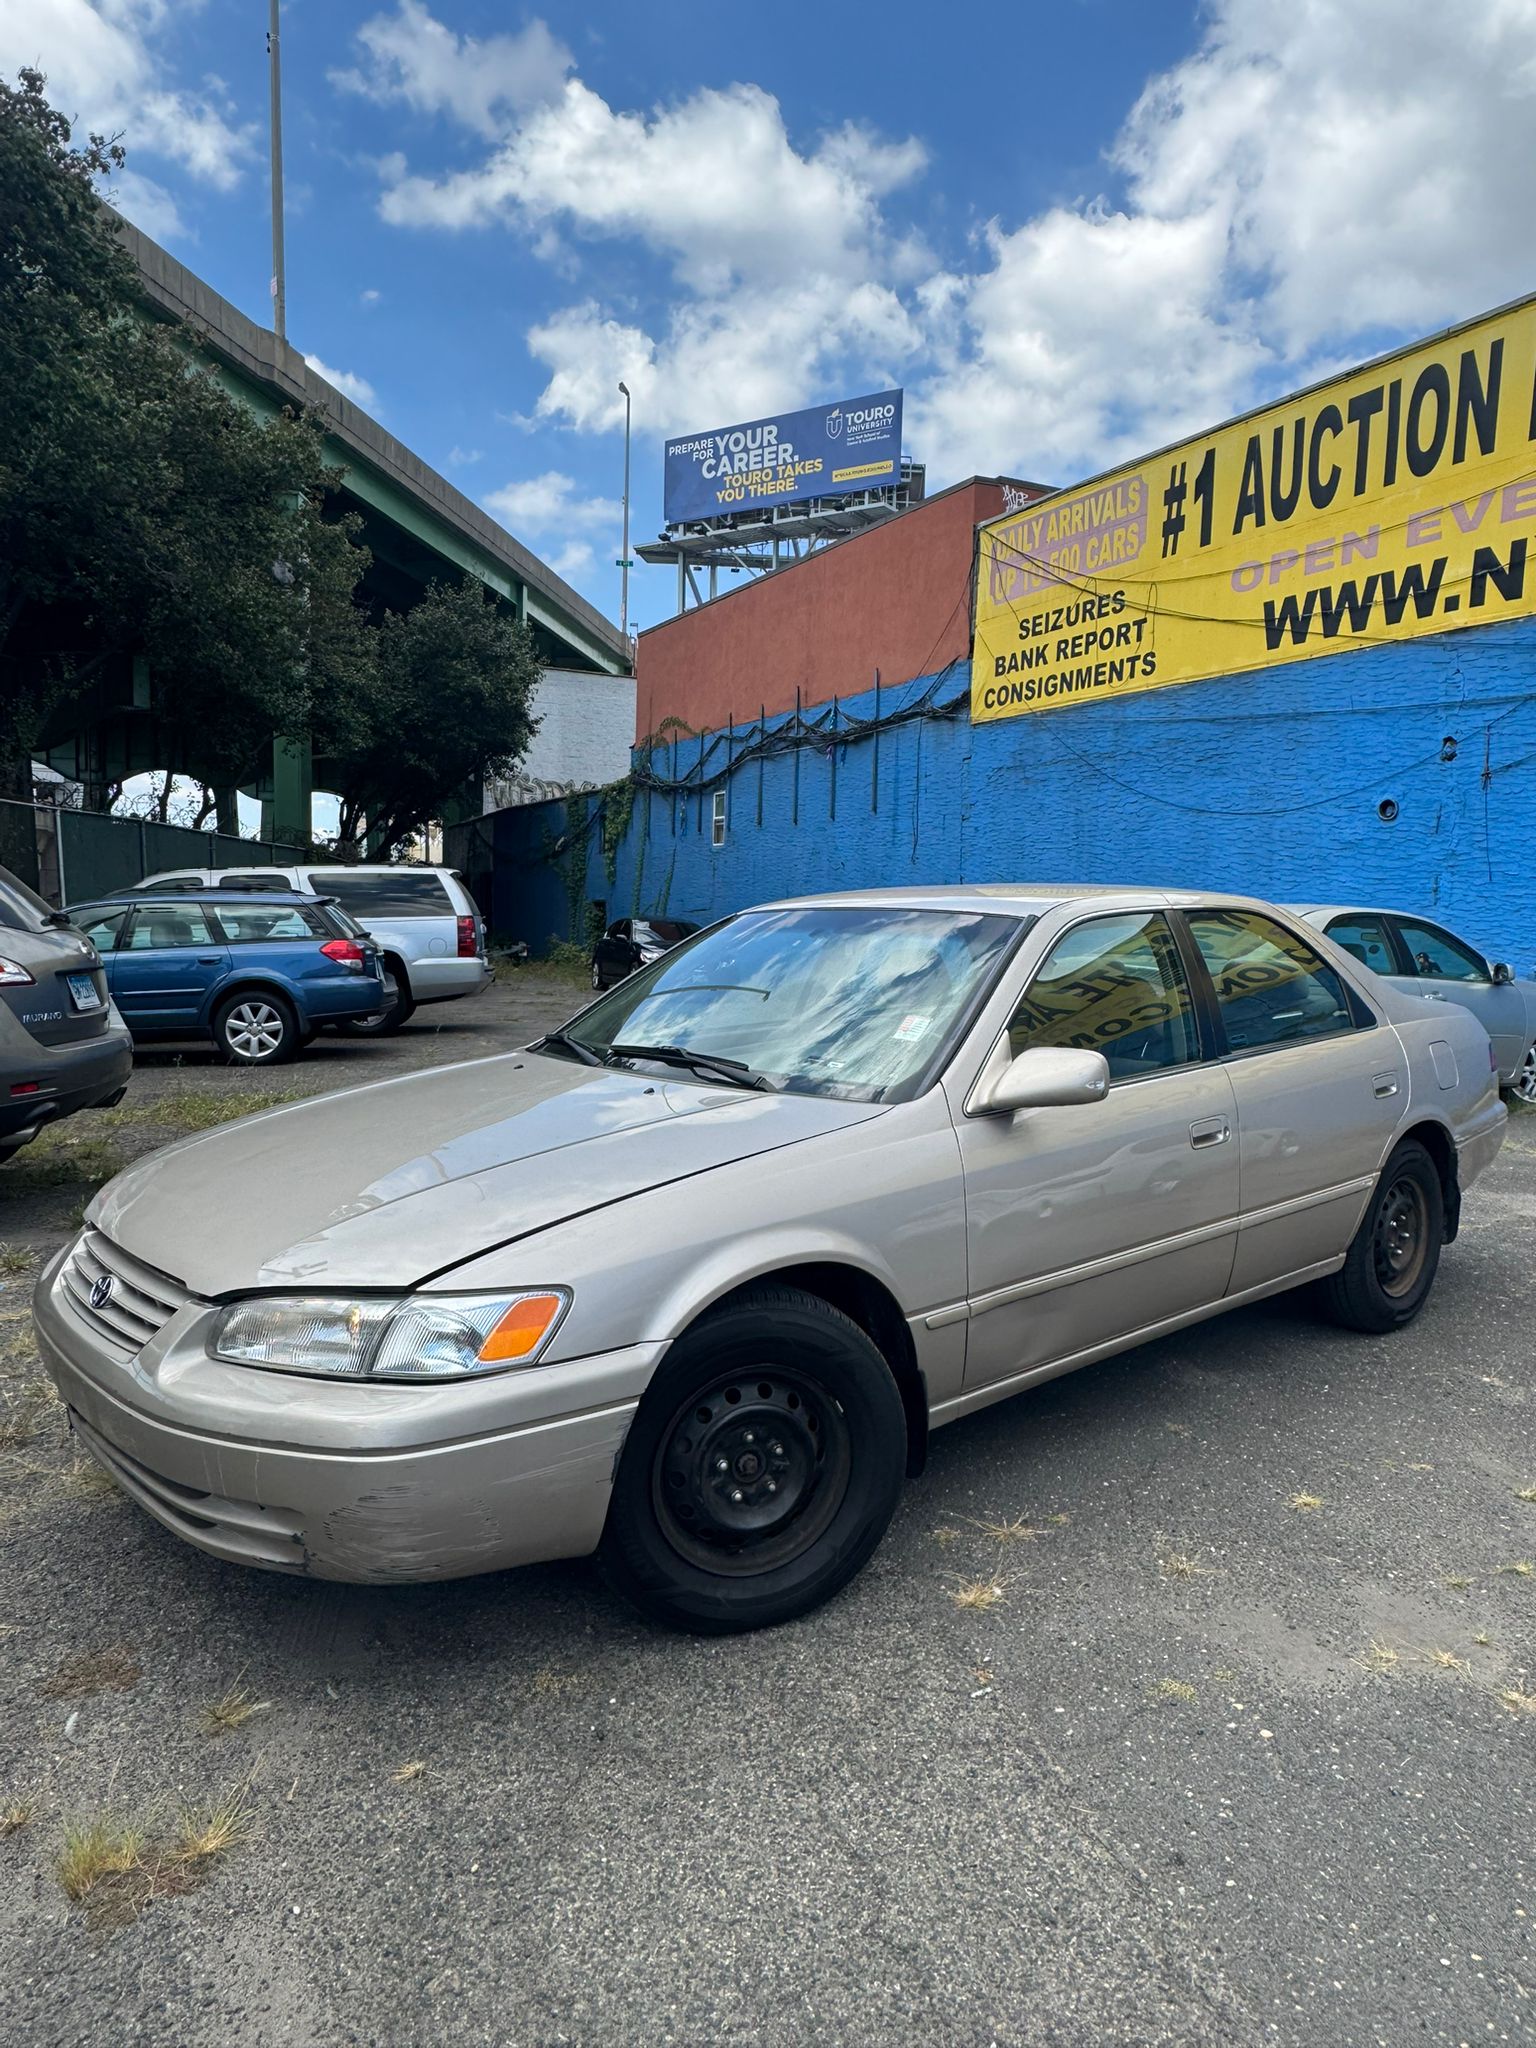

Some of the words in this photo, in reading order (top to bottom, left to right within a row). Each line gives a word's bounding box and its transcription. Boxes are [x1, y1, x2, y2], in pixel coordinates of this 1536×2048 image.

[845, 404, 895, 426] TOURO
[846, 417, 893, 433] UNIVERSITY
[669, 438, 714, 456] PREPARE
[715, 424, 778, 455] YOUR
[692, 448, 714, 462] FOR
[701, 443, 799, 479] CAREER.
[1162, 448, 1215, 558] #1
[1233, 338, 1505, 535] AUCTION
[716, 487, 745, 503] YOU
[748, 477, 799, 498] THERE.
[723, 468, 773, 489] TOURO
[776, 458, 824, 479] TAKES
[996, 517, 1044, 561] DAILY
[1047, 480, 1141, 544] ARRIVALS
[994, 567, 1017, 600] UP
[1050, 543, 1080, 579] 500
[1086, 522, 1140, 570] CARS
[1231, 524, 1380, 593] OPEN
[1018, 589, 1126, 640] SEIZURES
[994, 643, 1049, 677] BANK
[1056, 617, 1148, 662] REPORT
[984, 651, 1157, 710] CONSIGNMENTS
